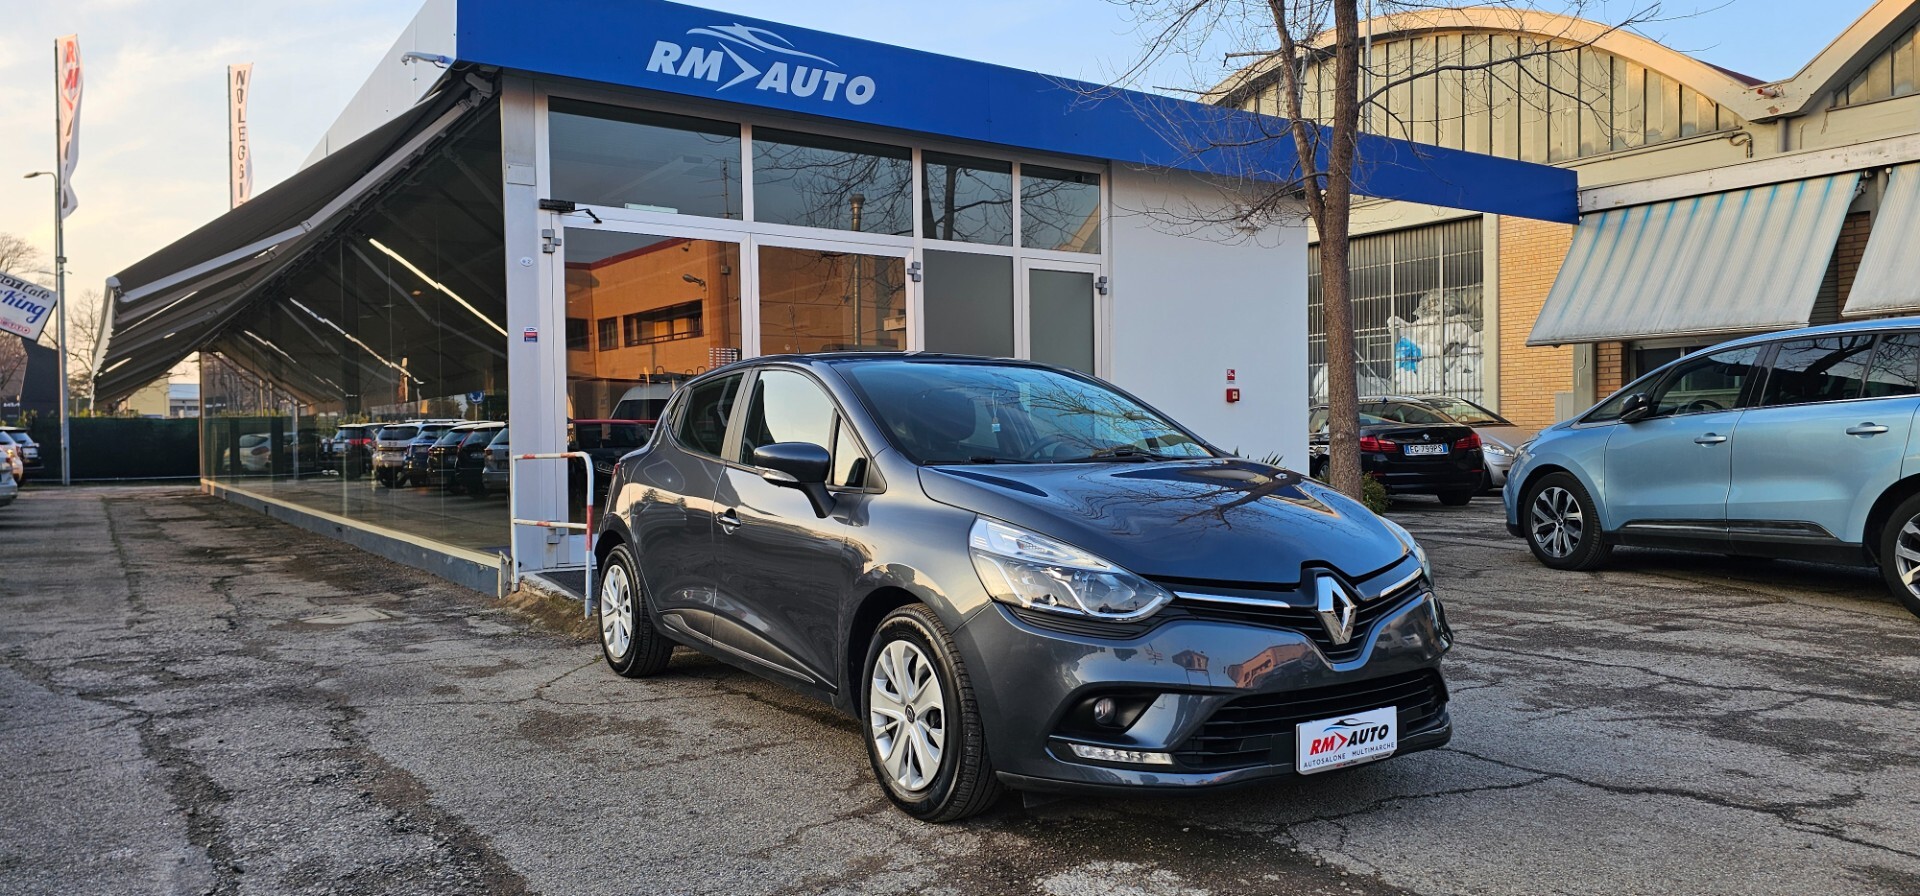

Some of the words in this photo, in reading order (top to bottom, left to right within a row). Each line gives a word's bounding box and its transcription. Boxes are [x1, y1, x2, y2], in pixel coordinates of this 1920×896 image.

[755, 61, 876, 105] AUTO
[235, 70, 247, 205] NOLEGGI
[1347, 724, 1389, 747] AUTO
[1303, 752, 1346, 768] AUTOSALONE
[1351, 741, 1395, 757] MULTIMARCHE
